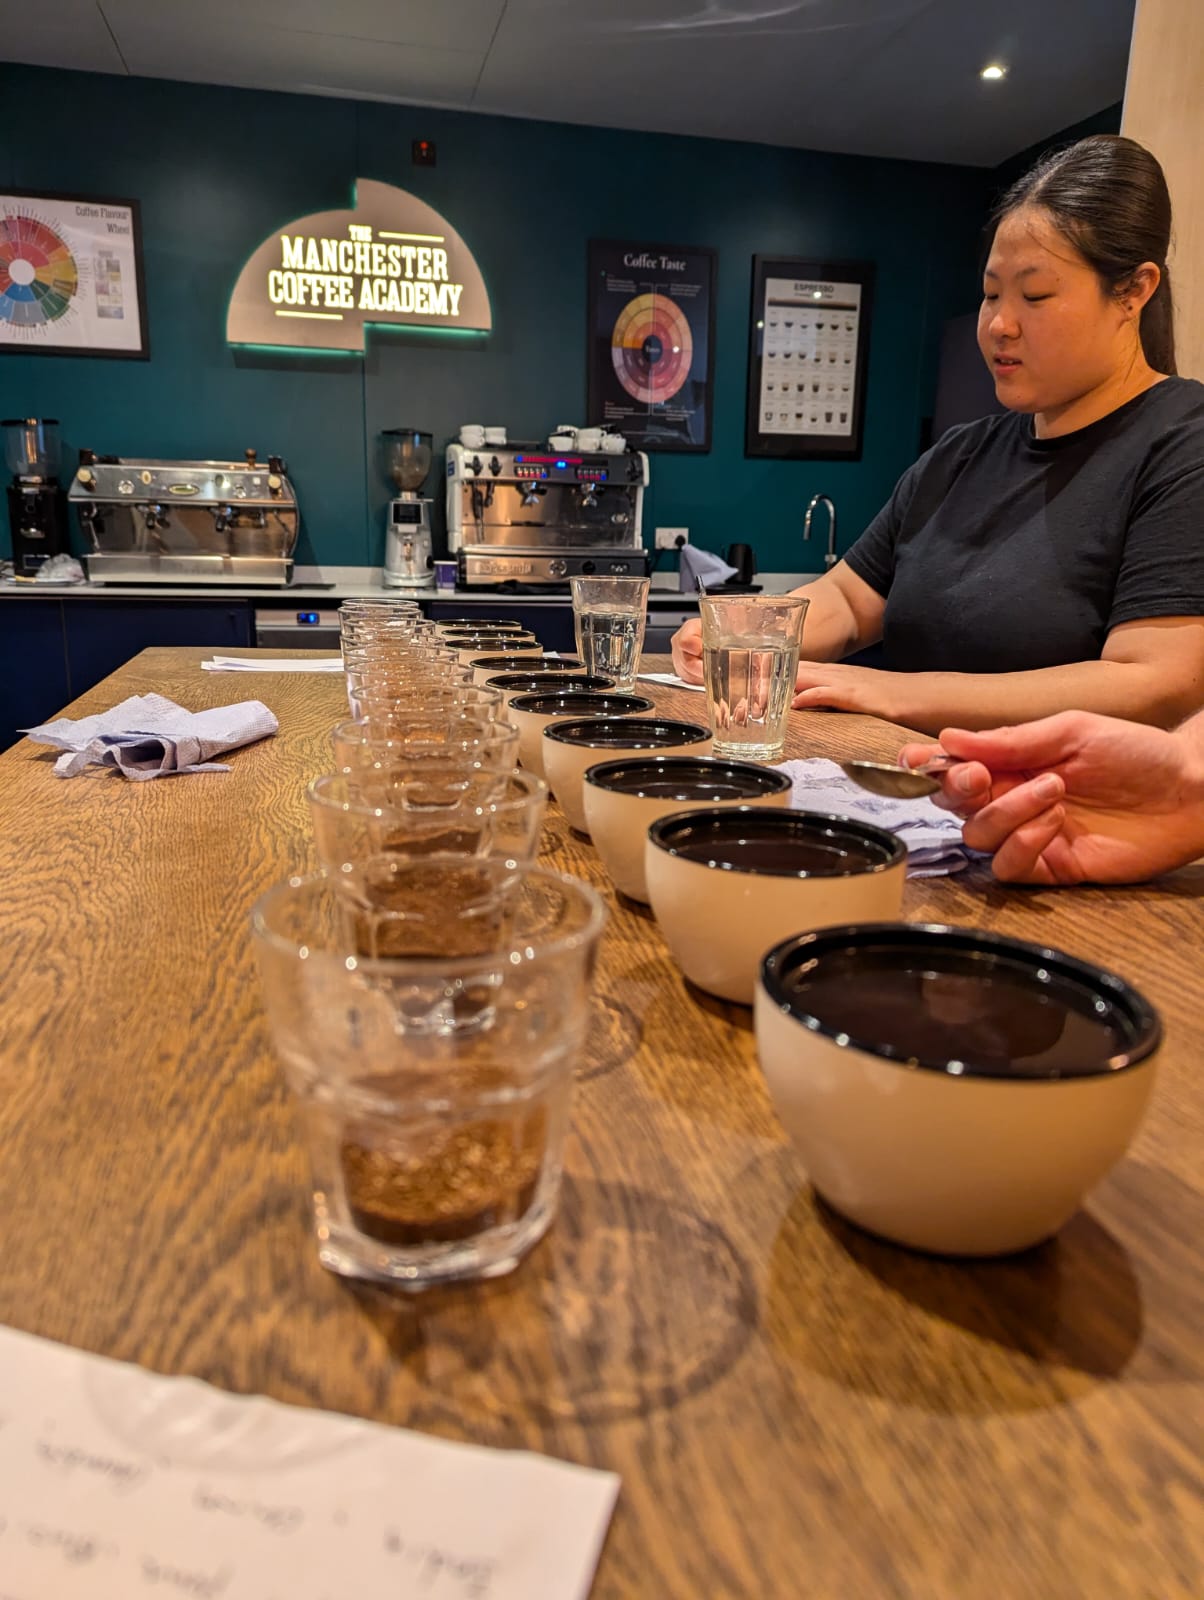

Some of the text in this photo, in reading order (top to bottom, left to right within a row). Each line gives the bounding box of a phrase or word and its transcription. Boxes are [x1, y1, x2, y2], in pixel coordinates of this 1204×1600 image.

[75, 206, 99, 217] Coffee
[348, 224, 372, 242] THE
[281, 235, 448, 281] MANCHESTER
[623, 253, 687, 271] Coffee Taste
[268, 270, 463, 316] COFFEE ACADEMY
[793, 282, 834, 293] ESPRESSO
